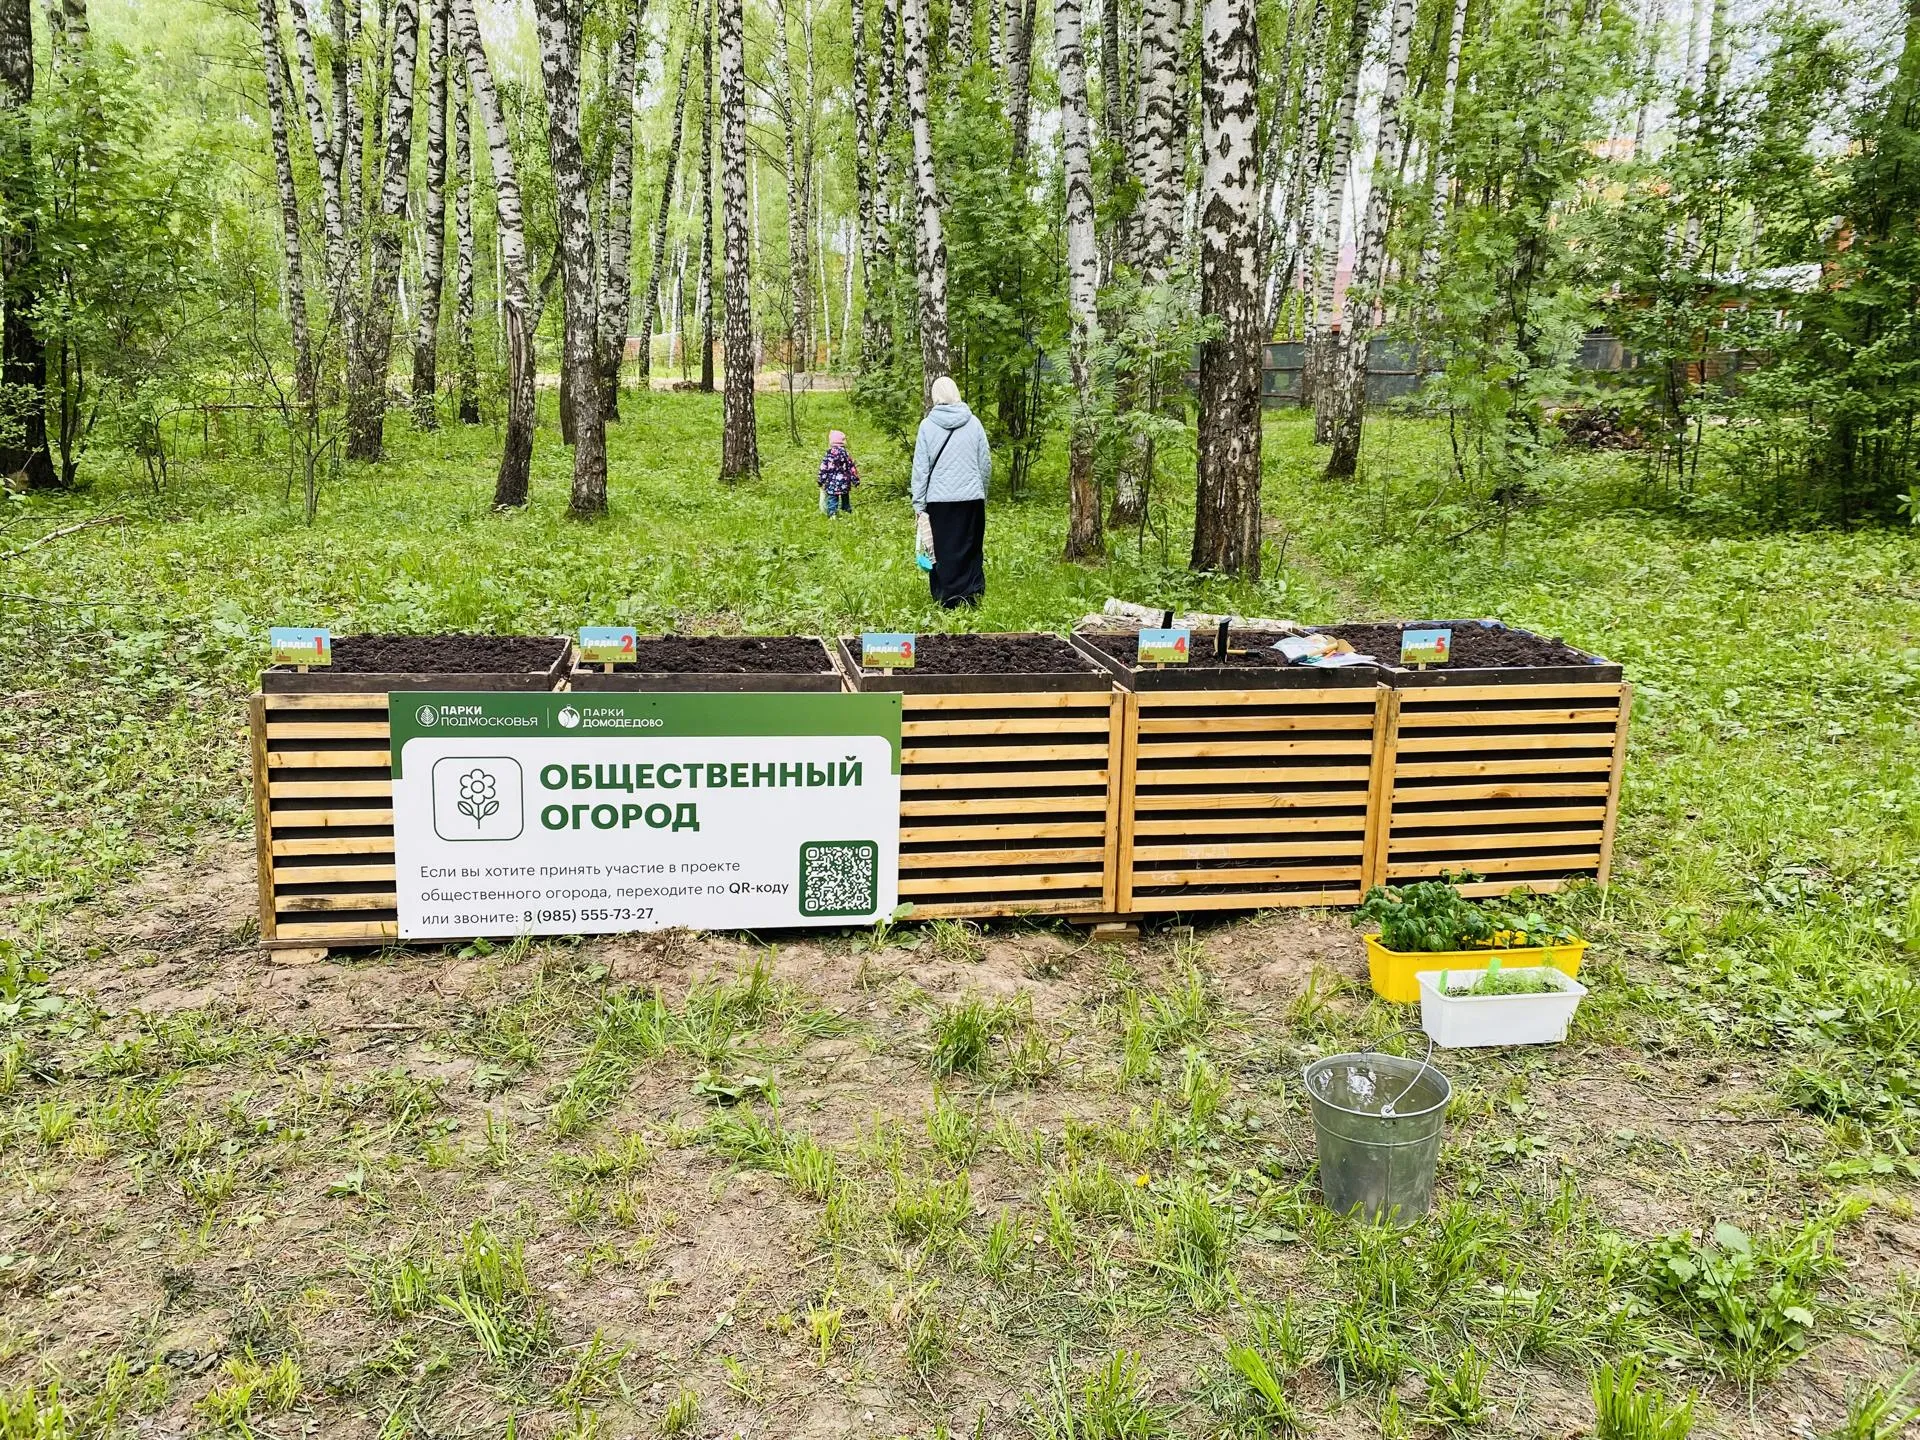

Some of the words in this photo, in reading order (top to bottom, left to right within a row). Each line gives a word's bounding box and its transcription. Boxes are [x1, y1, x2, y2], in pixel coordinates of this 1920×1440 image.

[315, 637, 323, 655] 1
[621, 635, 633, 652] 2
[900, 642, 912, 659] 3
[1174, 638, 1185, 653] 4
[1435, 637, 1445, 653] 5
[440, 706, 482, 715] ПАРКИ
[583, 708, 624, 717] ПАРКИ
[441, 717, 538, 727] ПОДМОСКОВЬЯ
[582, 718, 664, 728] ДОМОДЕДОВО
[540, 755, 863, 794] ОБЩЕСТВЕННЫЙ
[540, 803, 700, 832] ОГОРОД
[420, 866, 456, 878] Если
[461, 867, 480, 877] вы
[485, 866, 535, 877] хотите
[540, 865, 601, 878] принять
[605, 864, 664, 876] участие
[669, 864, 676, 873] в
[681, 862, 740, 875] проекте
[421, 888, 541, 902] общественного
[545, 888, 612, 900] огорода,
[616, 886, 703, 899] переходите
[707, 884, 725, 895] по
[729, 882, 789, 894] QR-коду
[422, 914, 449, 925] или
[454, 913, 519, 924] звоните:
[523, 910, 533, 922] 8
[537, 909, 576, 923] (985)
[580, 907, 654, 921] 555-73-27
